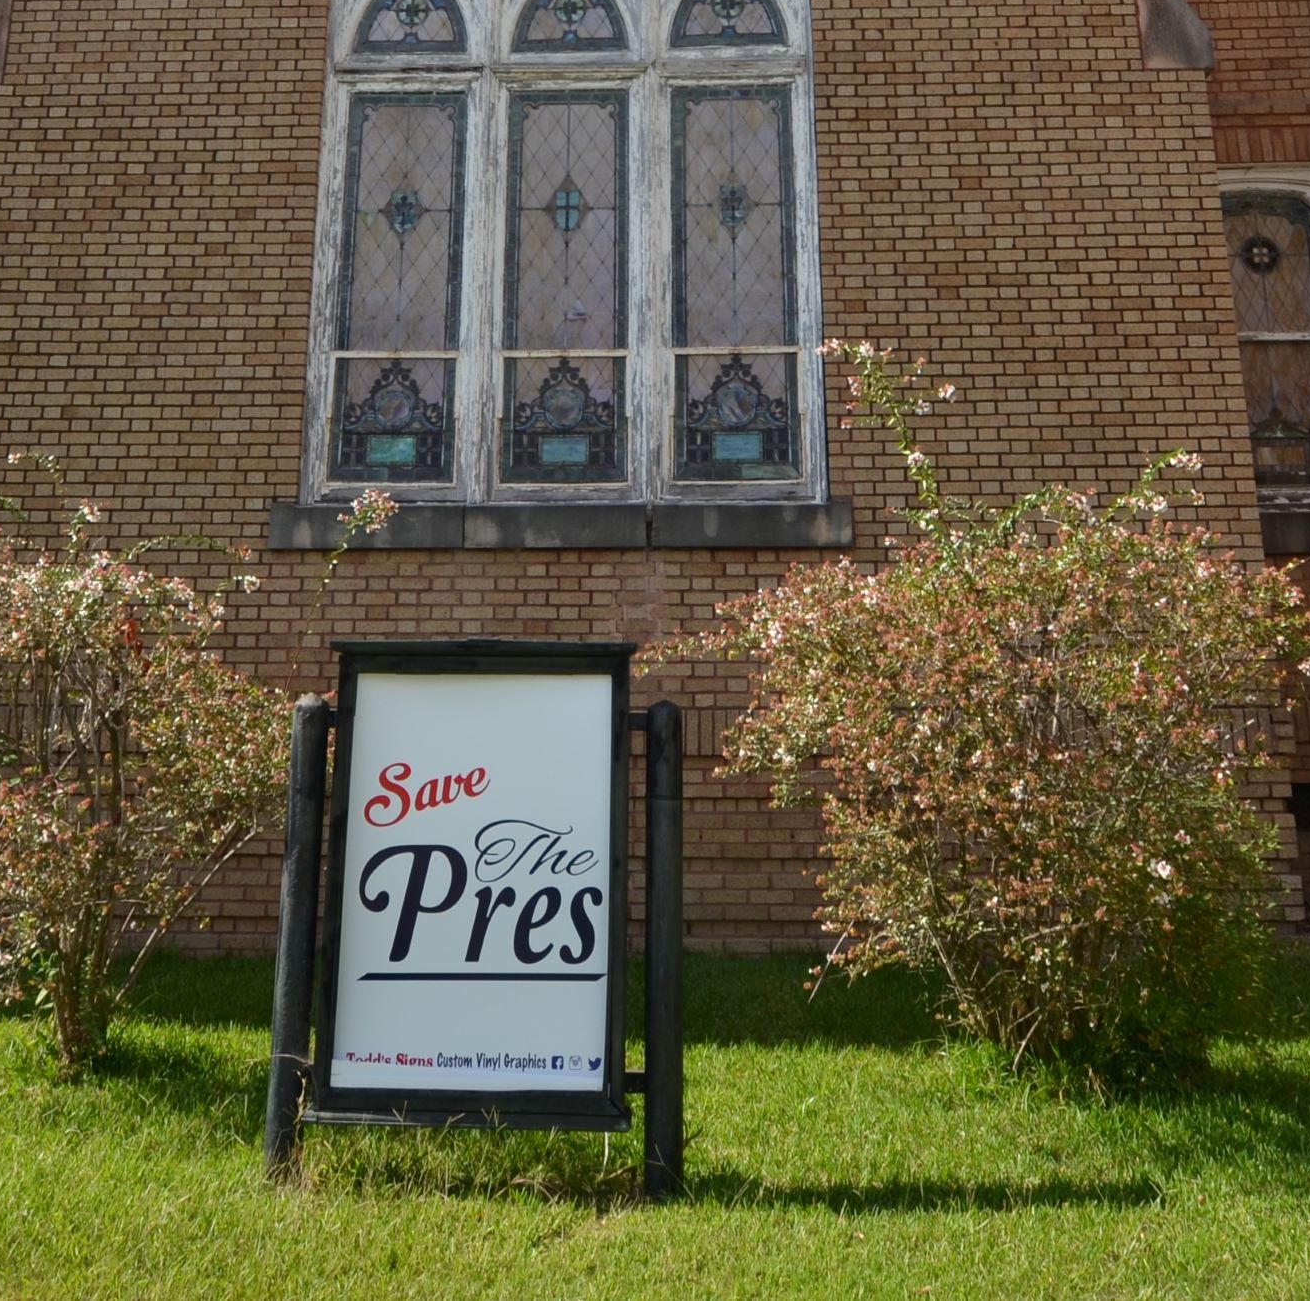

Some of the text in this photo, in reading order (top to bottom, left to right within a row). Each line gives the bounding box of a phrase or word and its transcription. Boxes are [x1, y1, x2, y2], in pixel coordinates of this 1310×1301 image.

[363, 762, 491, 828] Save
[474, 819, 600, 883] The
[358, 844, 604, 965] Pres
[395, 1052, 434, 1067] Signs
[436, 1051, 473, 1068] Custom
[476, 1052, 501, 1072] Vinyl
[504, 1052, 547, 1073] Graphics
